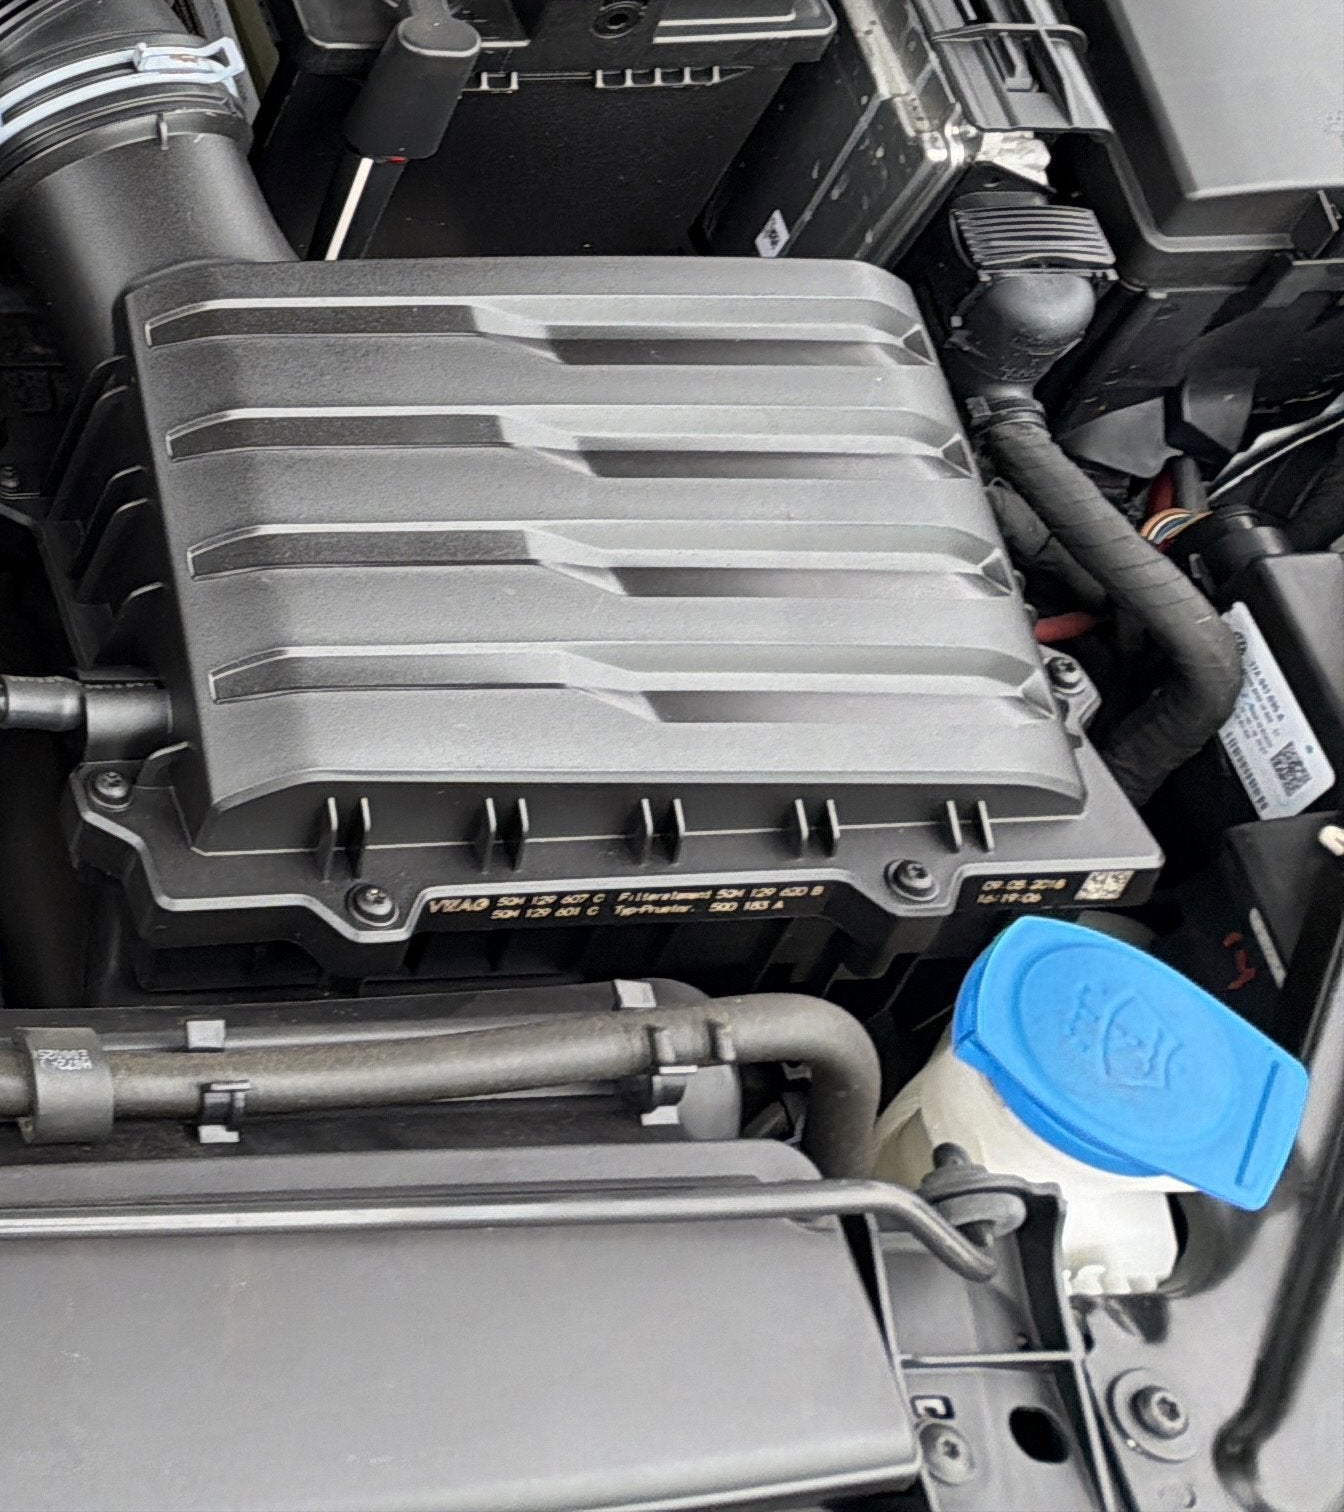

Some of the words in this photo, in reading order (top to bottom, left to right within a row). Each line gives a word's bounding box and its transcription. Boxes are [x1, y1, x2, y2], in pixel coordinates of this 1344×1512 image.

[531, 895, 558, 906] 129
[750, 887, 777, 898] 129
[525, 907, 553, 918] 129
